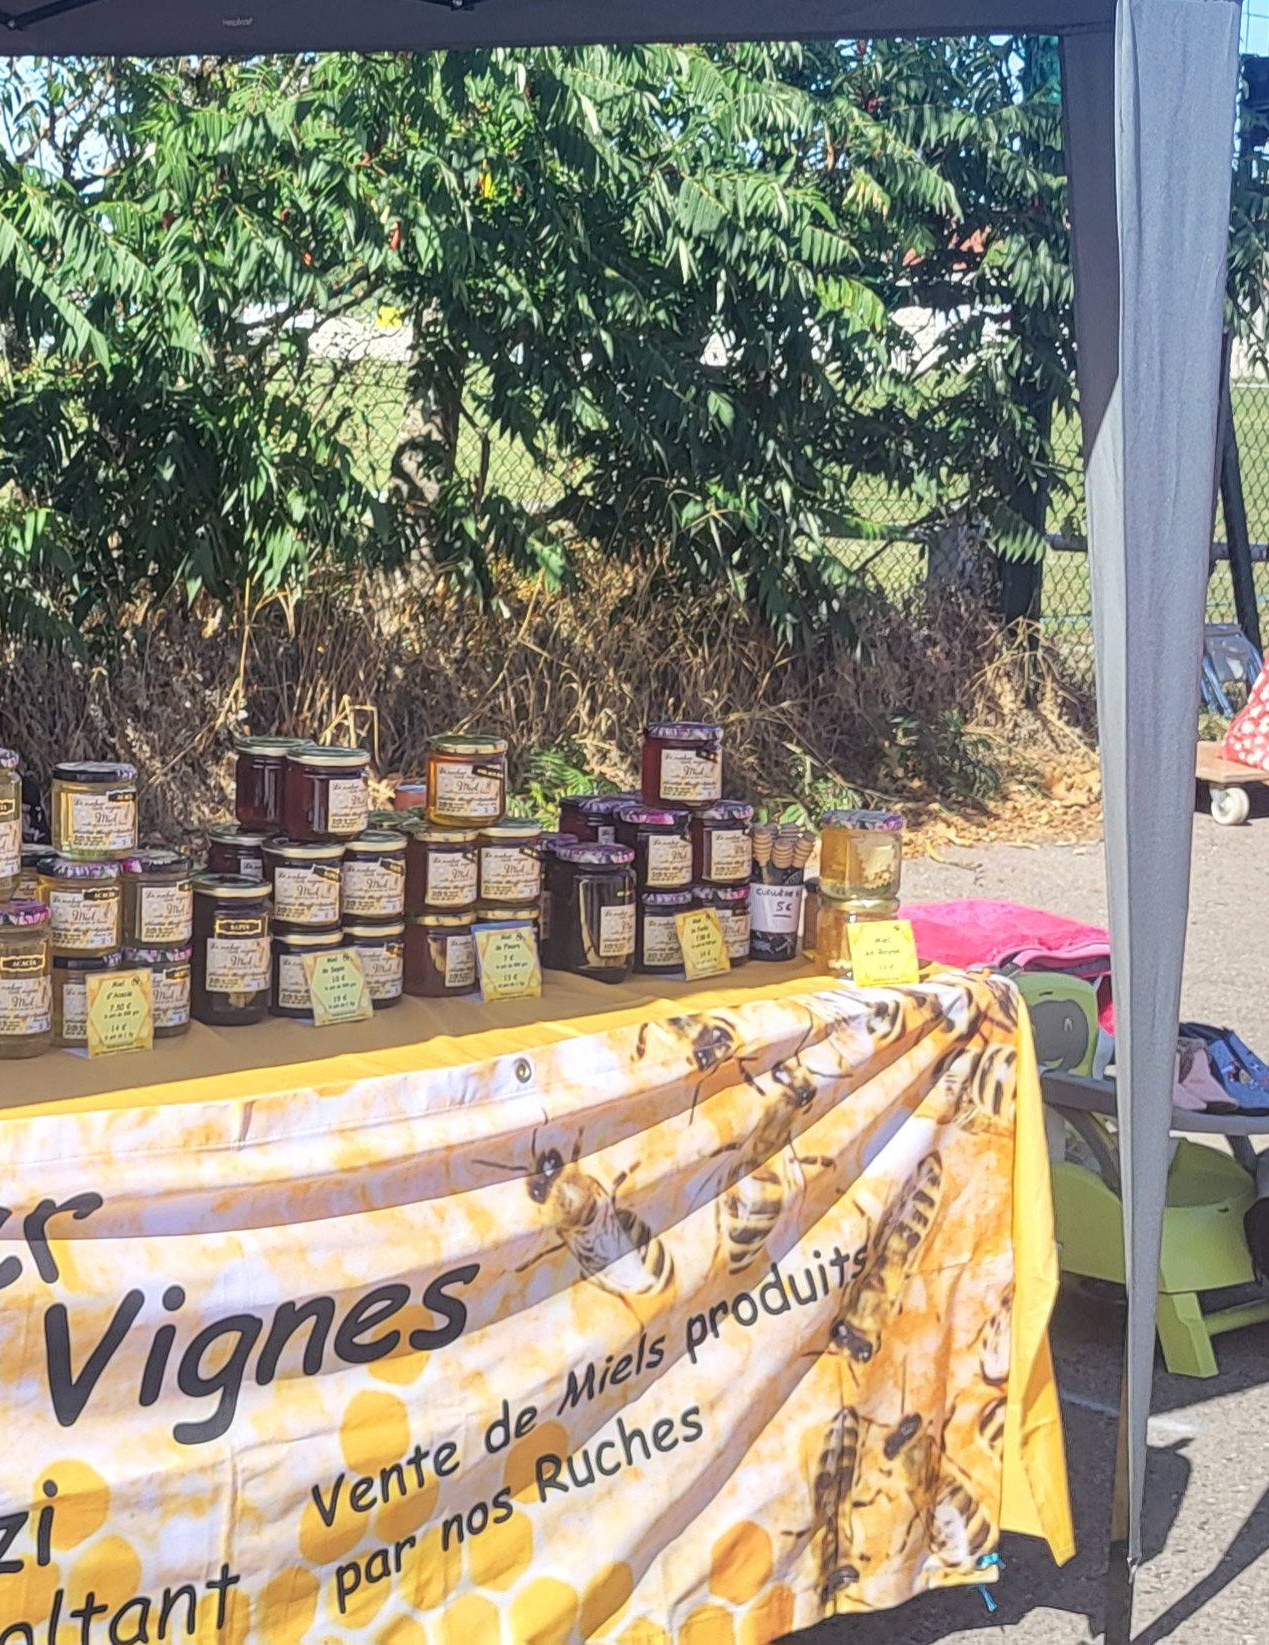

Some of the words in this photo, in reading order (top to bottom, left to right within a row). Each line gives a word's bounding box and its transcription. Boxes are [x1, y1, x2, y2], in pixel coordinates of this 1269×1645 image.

[44, 1263, 480, 1445] Vignes
[311, 1440, 461, 1528] Vente
[485, 1399, 537, 1454] de
[558, 1331, 666, 1417] Miels
[685, 1243, 869, 1363] produits
[335, 1533, 416, 1614] par
[441, 1486, 514, 1551] nos
[535, 1405, 705, 1504] Ruches
